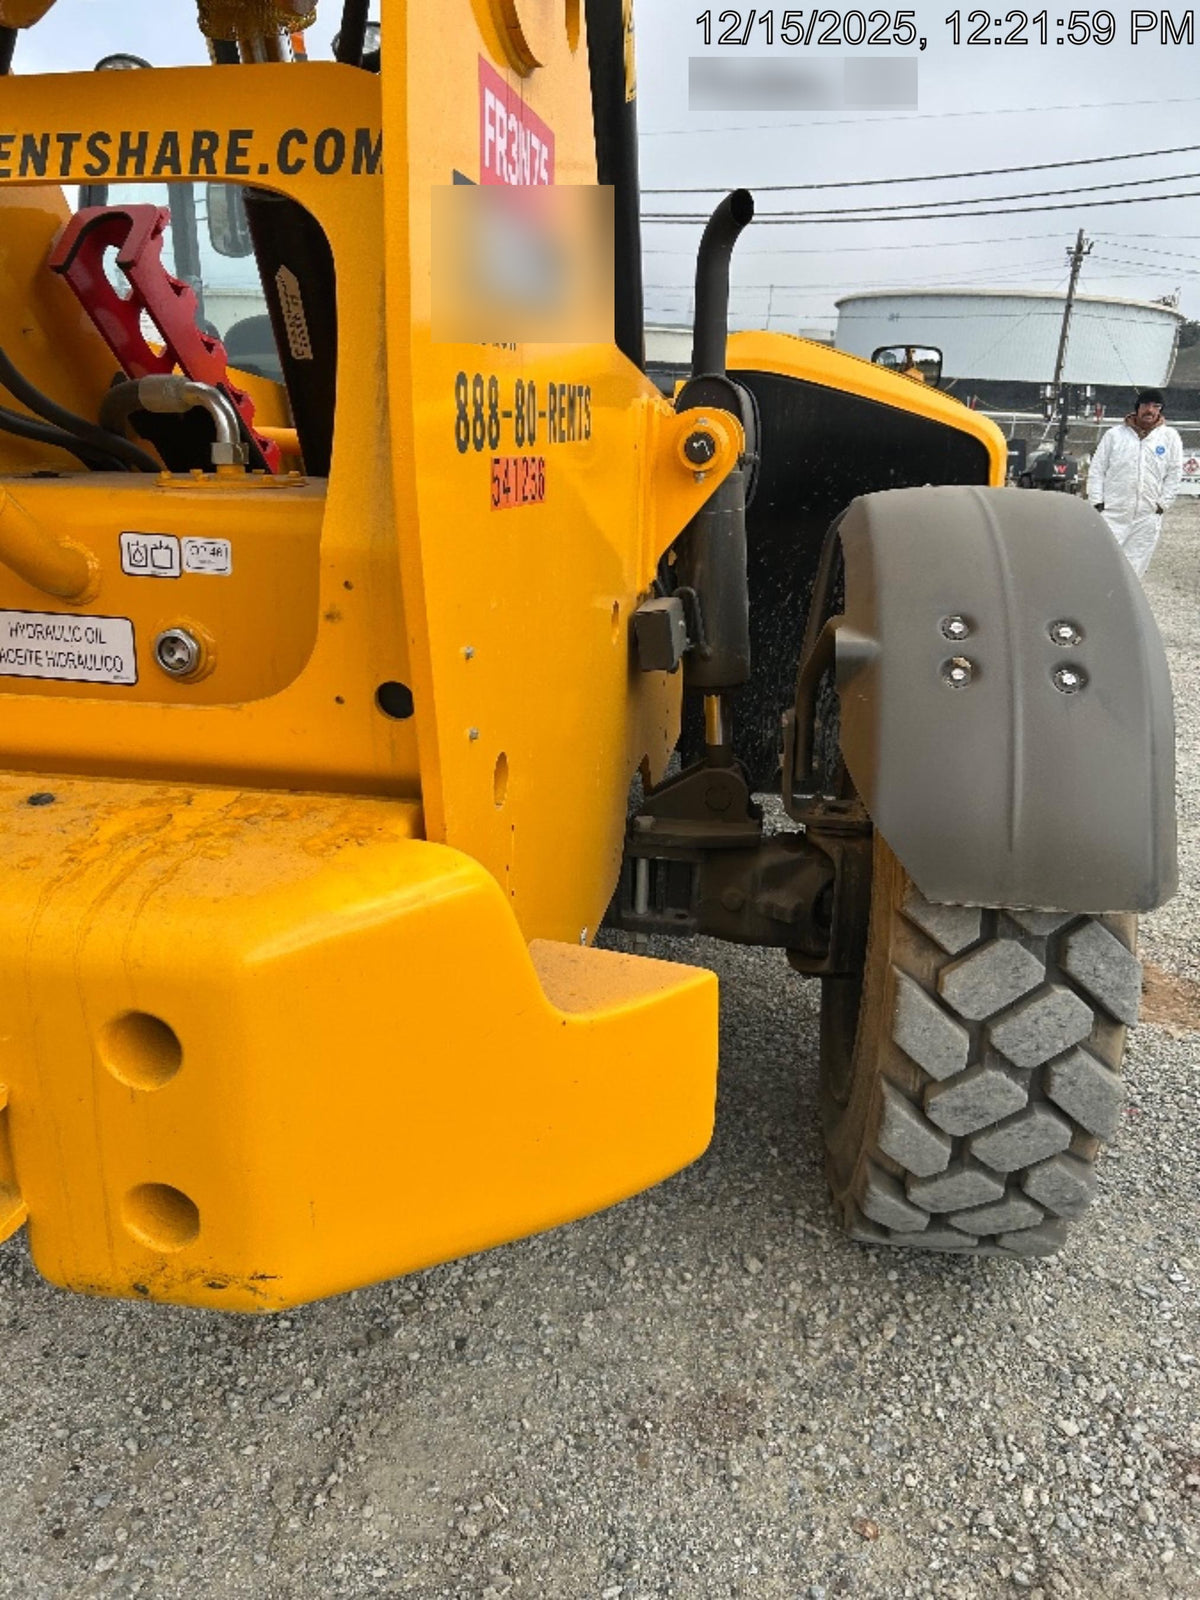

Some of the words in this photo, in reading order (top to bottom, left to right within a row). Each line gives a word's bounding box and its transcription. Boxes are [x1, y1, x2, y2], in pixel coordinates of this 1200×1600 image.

[455, 371, 591, 454] 888-80-RENTS
[9, 621, 82, 643] HYDRAULIC
[84, 627, 107, 644] OIL
